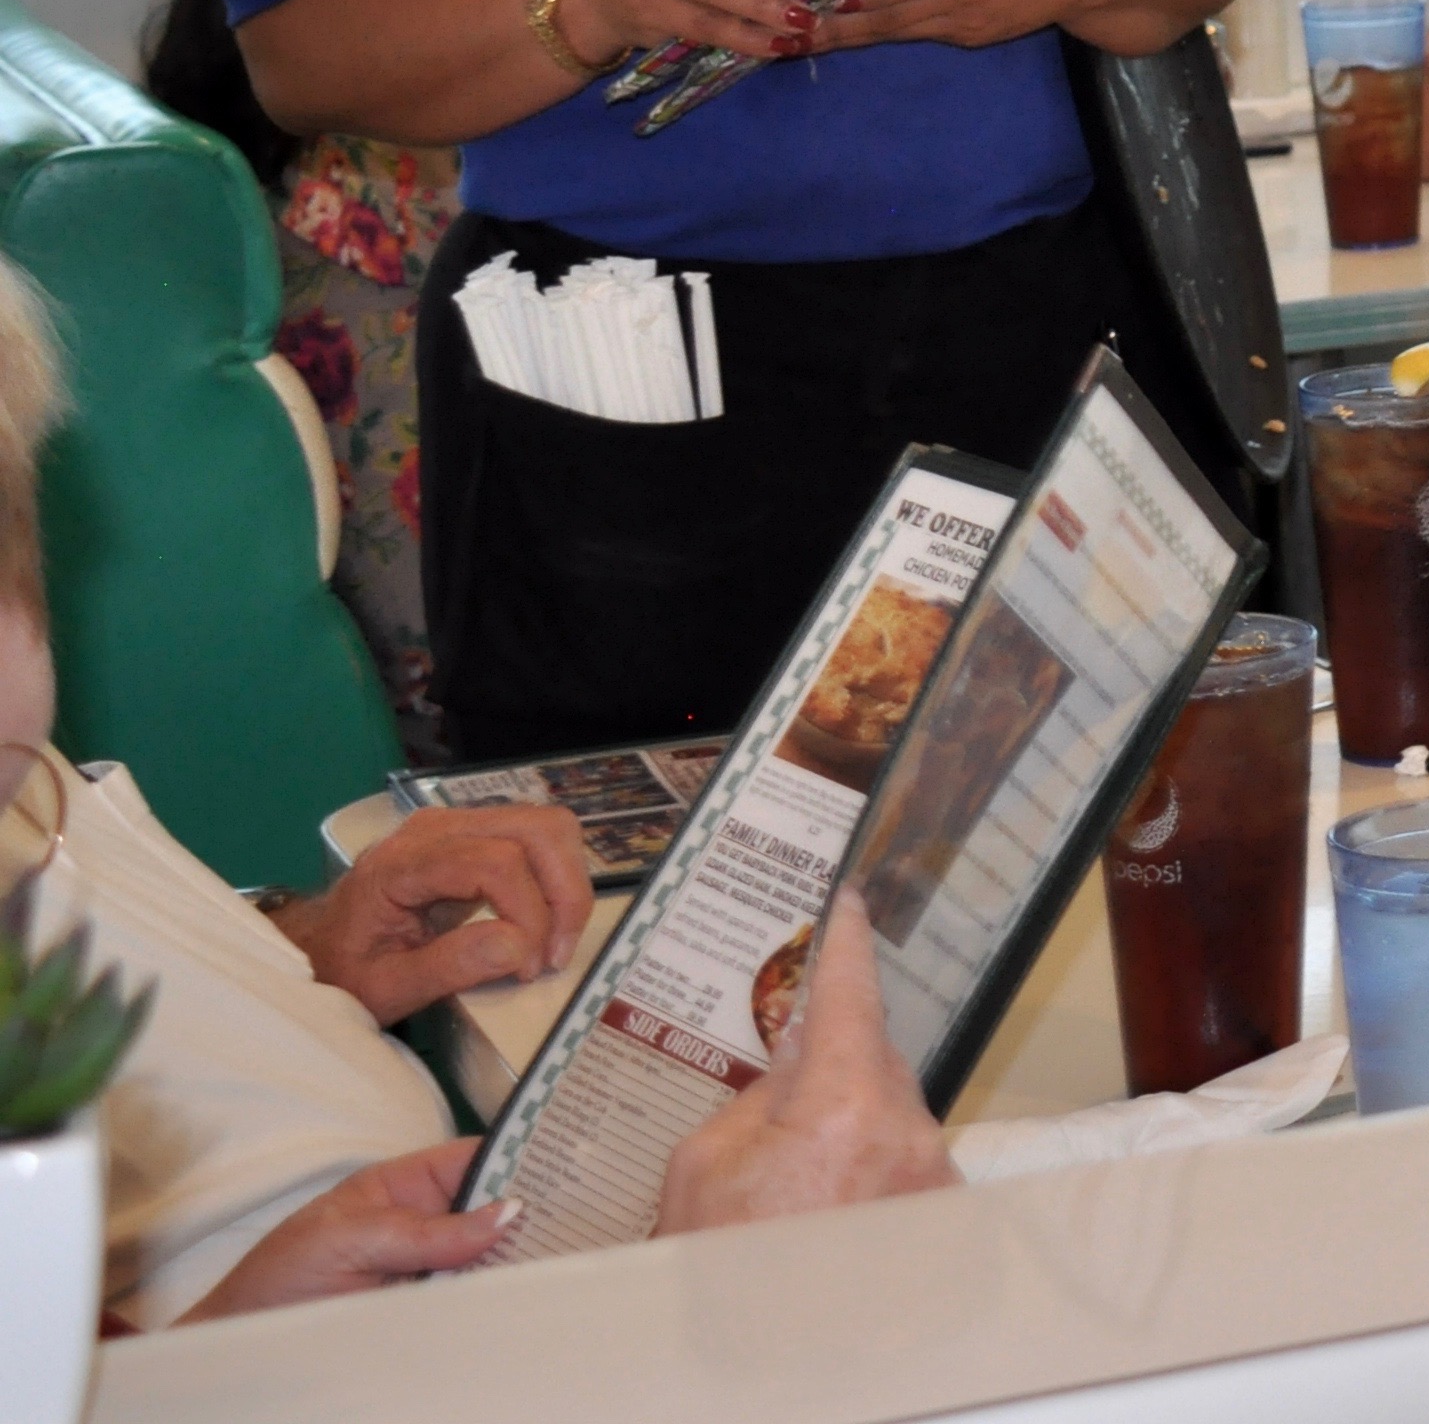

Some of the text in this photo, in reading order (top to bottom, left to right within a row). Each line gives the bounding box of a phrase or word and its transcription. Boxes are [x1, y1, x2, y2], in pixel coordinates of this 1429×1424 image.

[895, 498, 930, 528] WE
[903, 556, 950, 586] CHICKEN
[926, 539, 987, 572] HOMEMAD
[722, 816, 768, 850] FAMILY
[764, 836, 815, 872] DINNER
[622, 1008, 734, 1078] SIDE ORDERS
